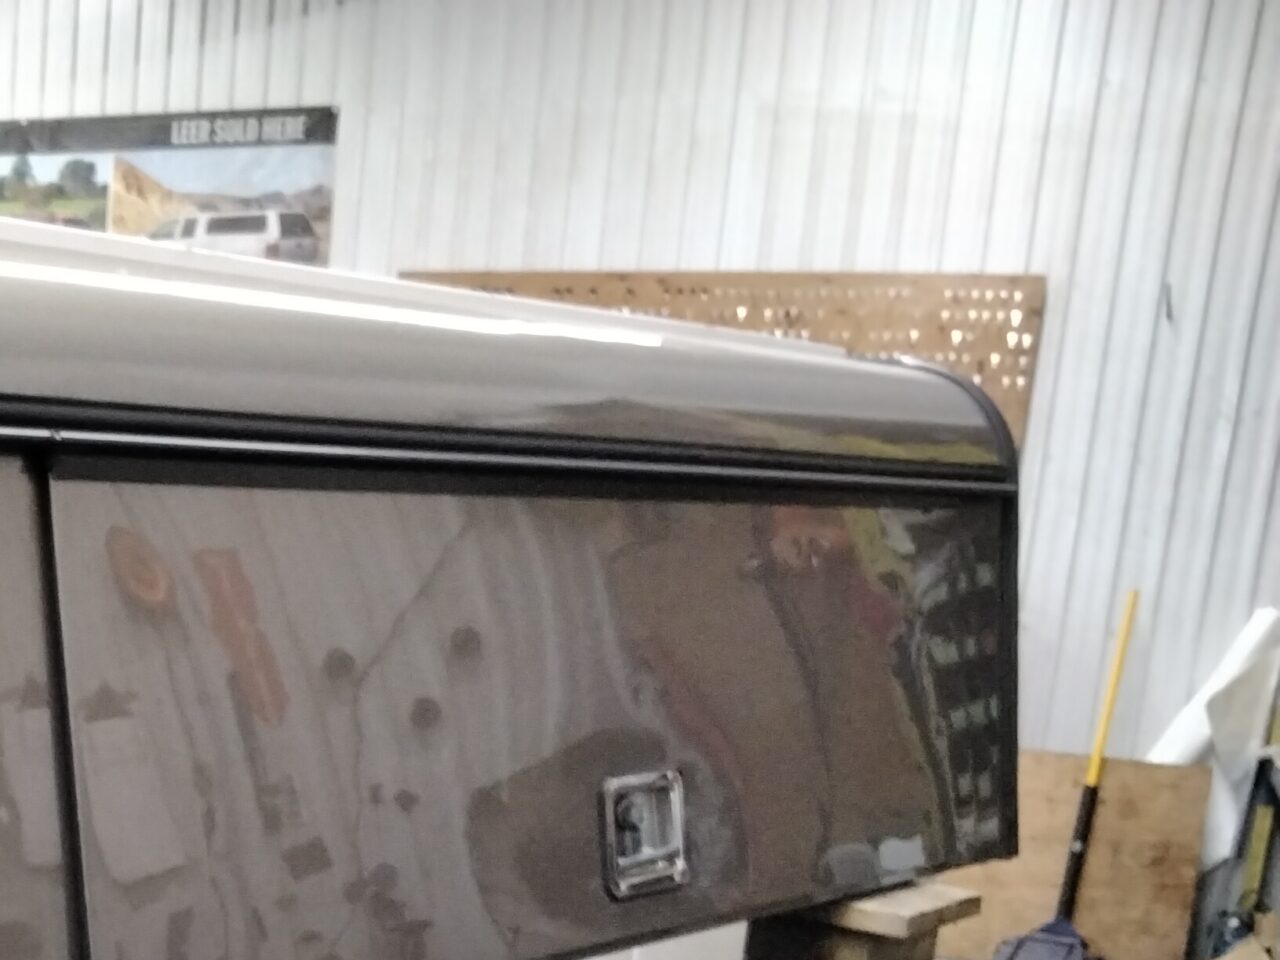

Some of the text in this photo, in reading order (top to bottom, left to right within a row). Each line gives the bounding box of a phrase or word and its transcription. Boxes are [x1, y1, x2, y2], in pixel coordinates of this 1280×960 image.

[171, 115, 306, 144] LEER SOLD HERE
